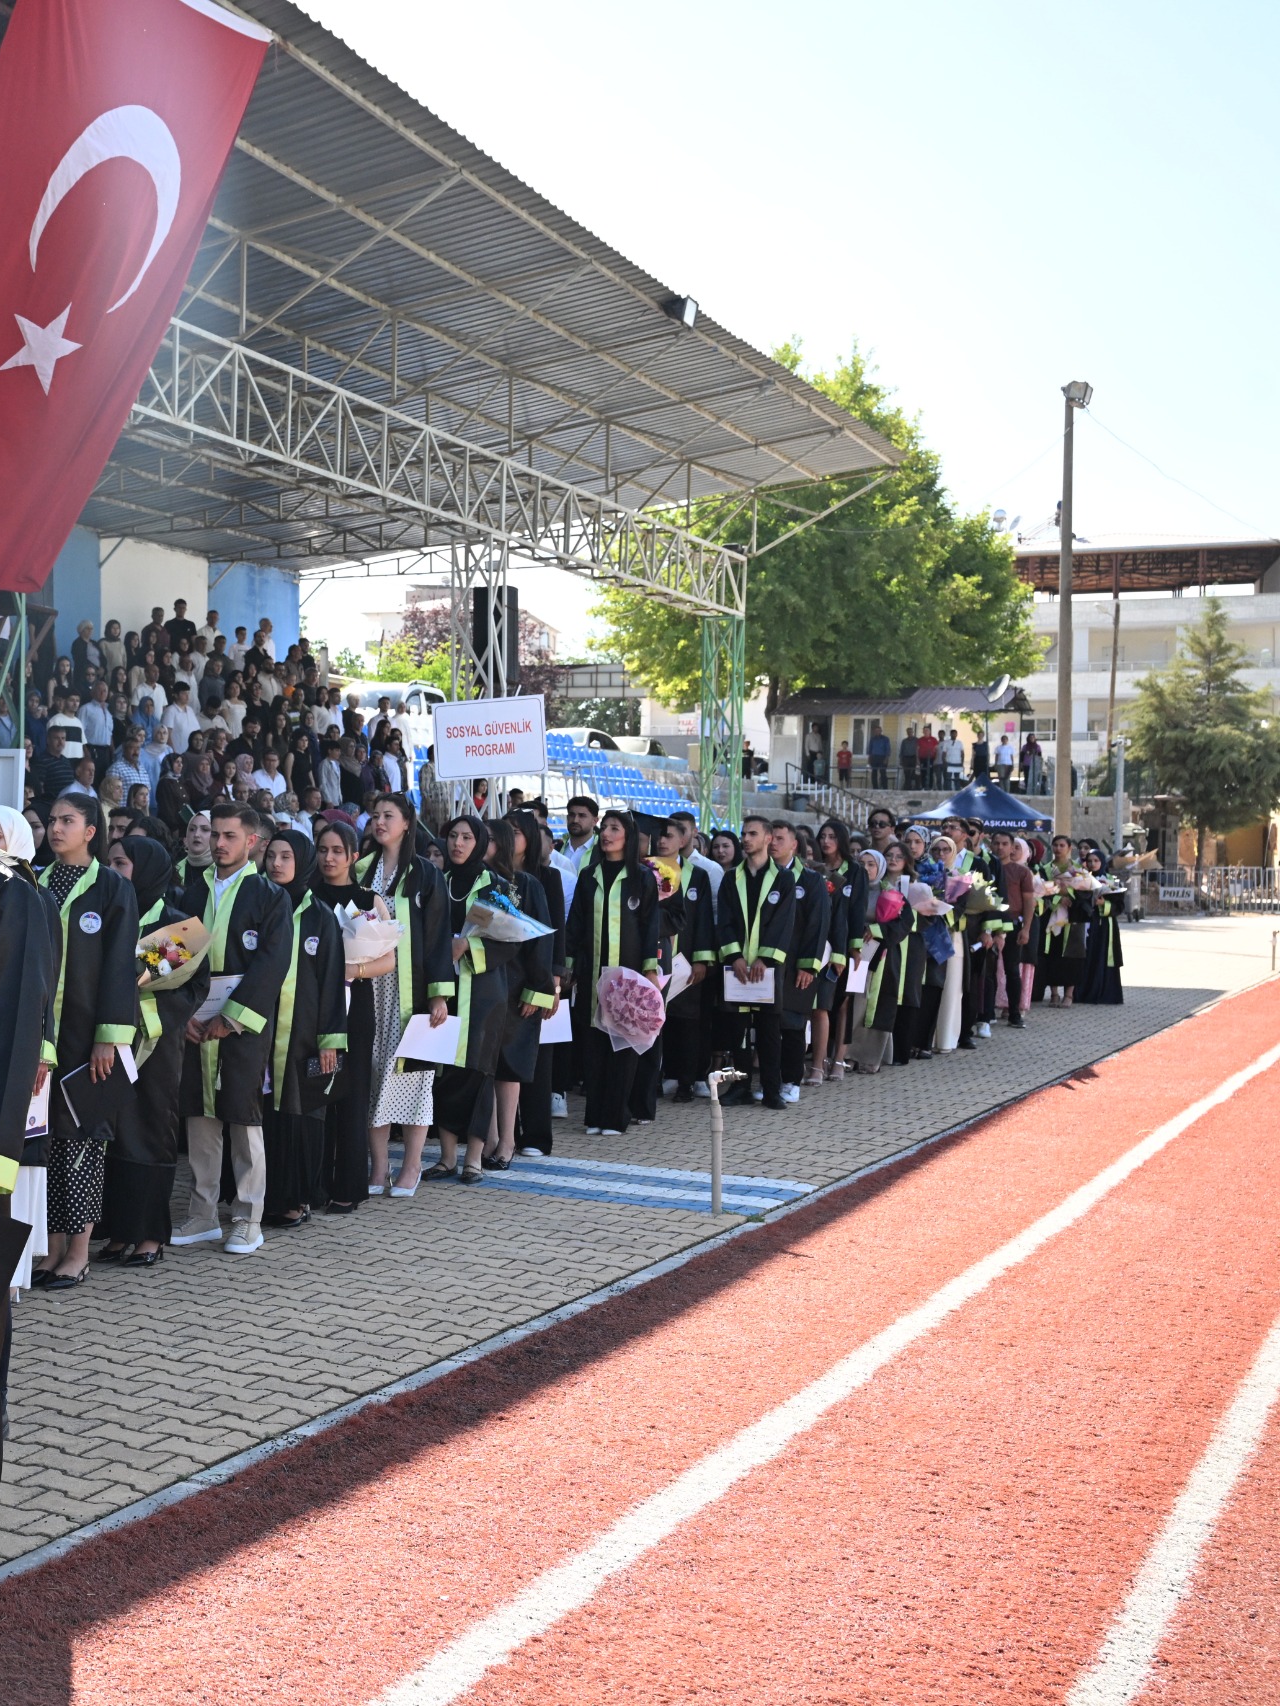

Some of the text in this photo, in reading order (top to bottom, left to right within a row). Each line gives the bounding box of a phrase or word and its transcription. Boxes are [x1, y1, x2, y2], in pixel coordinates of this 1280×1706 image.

[446, 718, 532, 739] SOSYAL GÜVENLİK
[465, 742, 515, 757] PROGRAMI
[982, 819, 1028, 828] AŞKANLIĞ
[1162, 888, 1191, 898] POLİS
